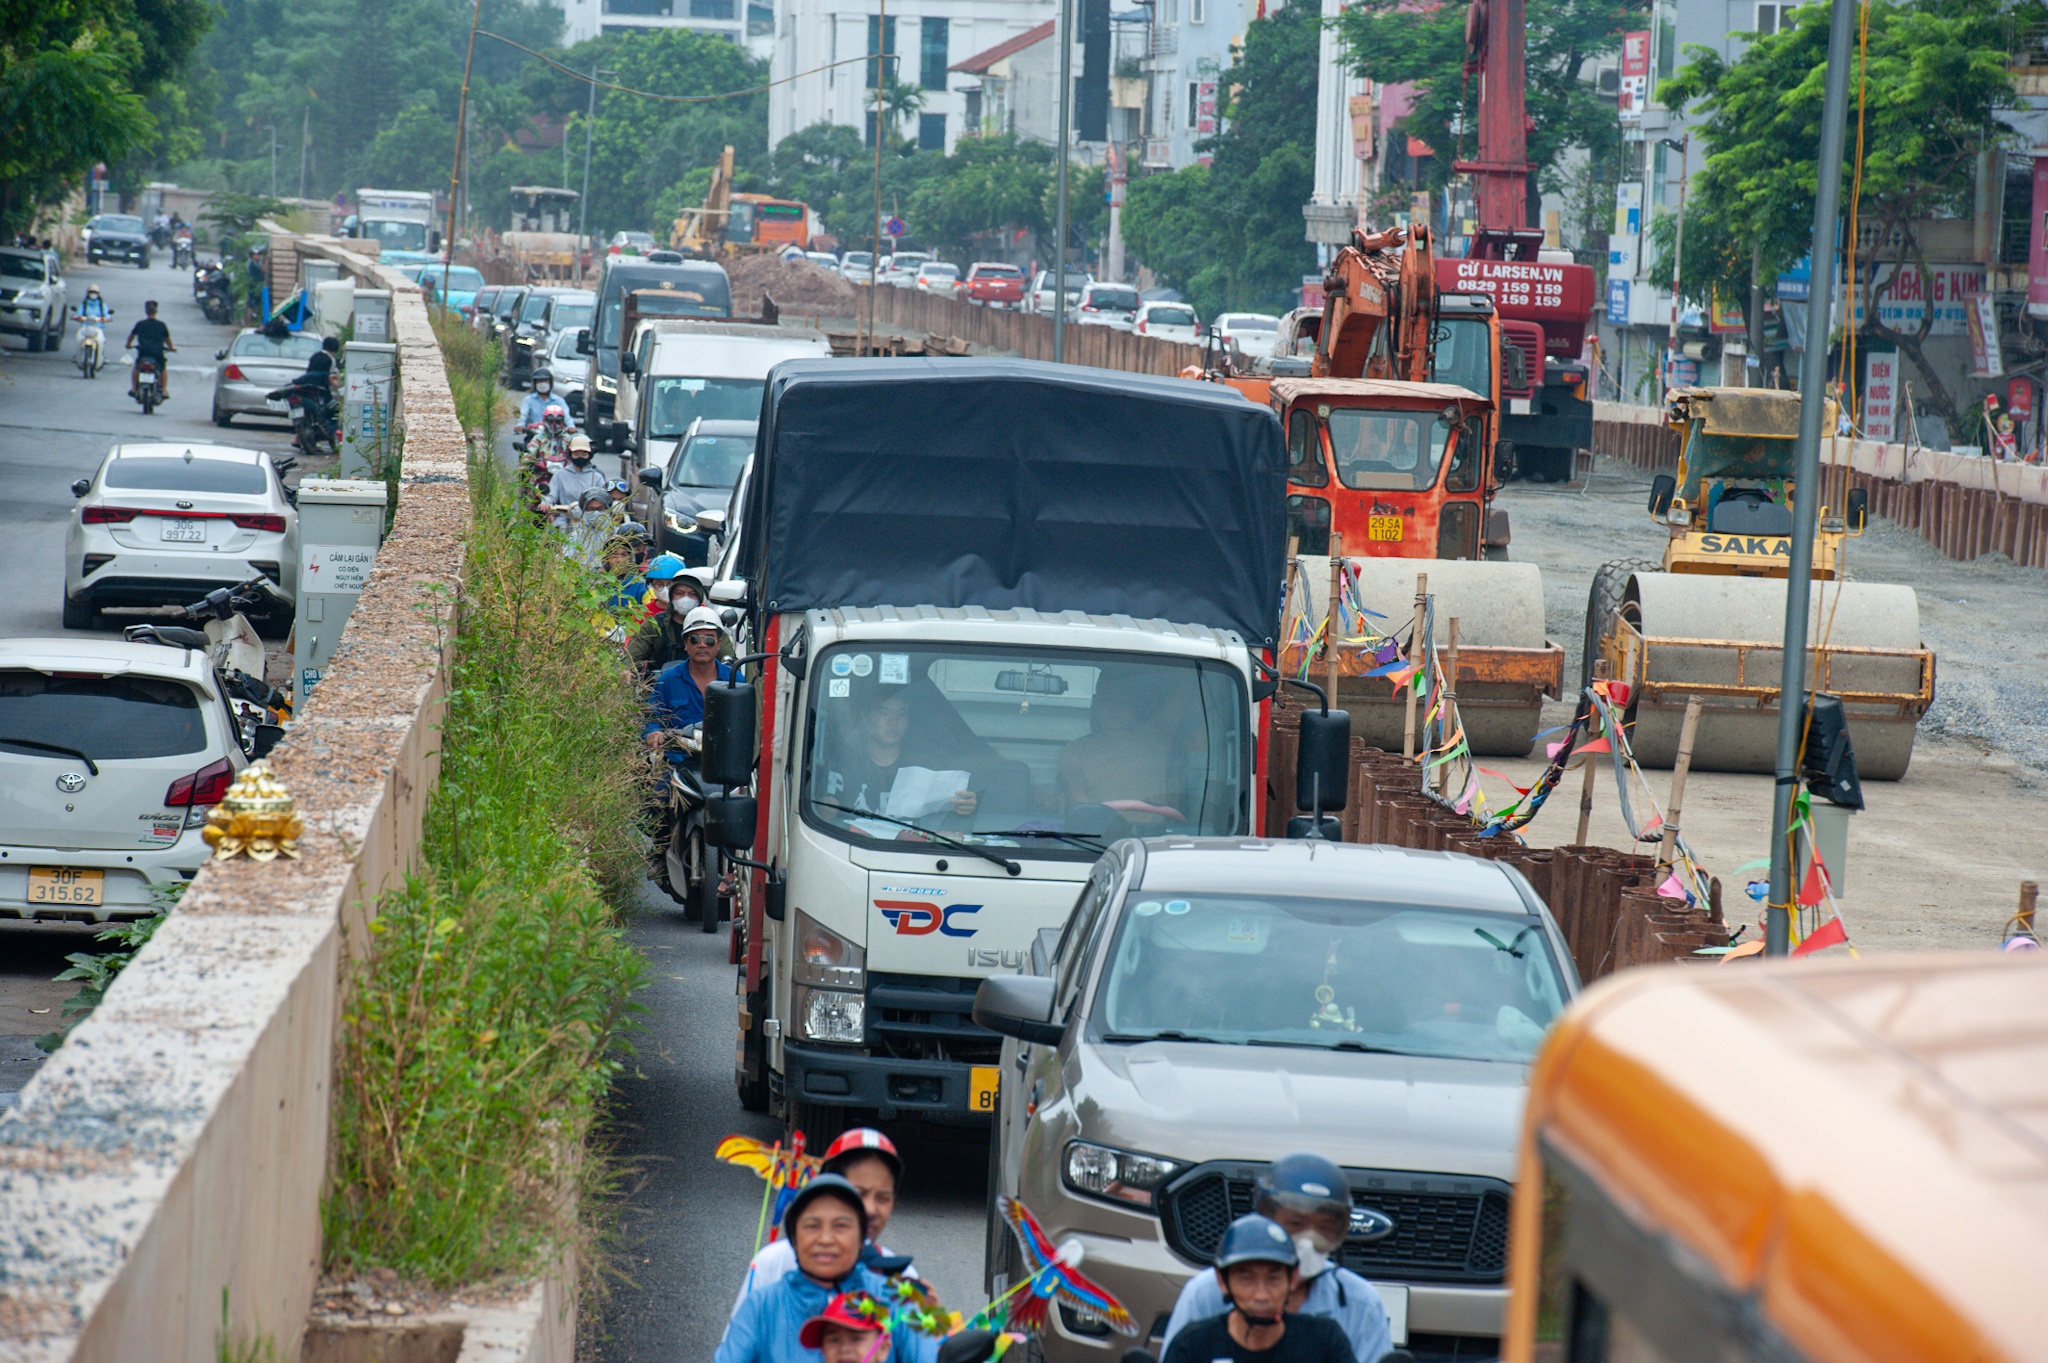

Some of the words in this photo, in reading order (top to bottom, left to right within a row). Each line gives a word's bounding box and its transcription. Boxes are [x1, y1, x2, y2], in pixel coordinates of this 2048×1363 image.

[1457, 260, 1480, 277] CỪ
[1482, 263, 1563, 282] LARSEN.VN
[1457, 279, 1497, 292] 0829
[1502, 281, 1530, 293] 159
[1535, 283, 1563, 295] 159
[1950, 271, 1979, 301] KIM
[1501, 293, 1529, 305] 159
[1534, 295, 1562, 307] 159
[1871, 361, 1891, 382] ĐIỆN
[1869, 383, 1891, 400] NƯỚC
[174, 520, 194, 530] 30G
[166, 530, 201, 540] 997.22
[1374, 529, 1399, 541] 1102
[1701, 535, 1791, 556] SAKA
[304, 669, 318, 679] CHO
[50, 869, 83, 885] 30F
[36, 885, 95, 902] 315.62
[967, 947, 1029, 968] ISU
